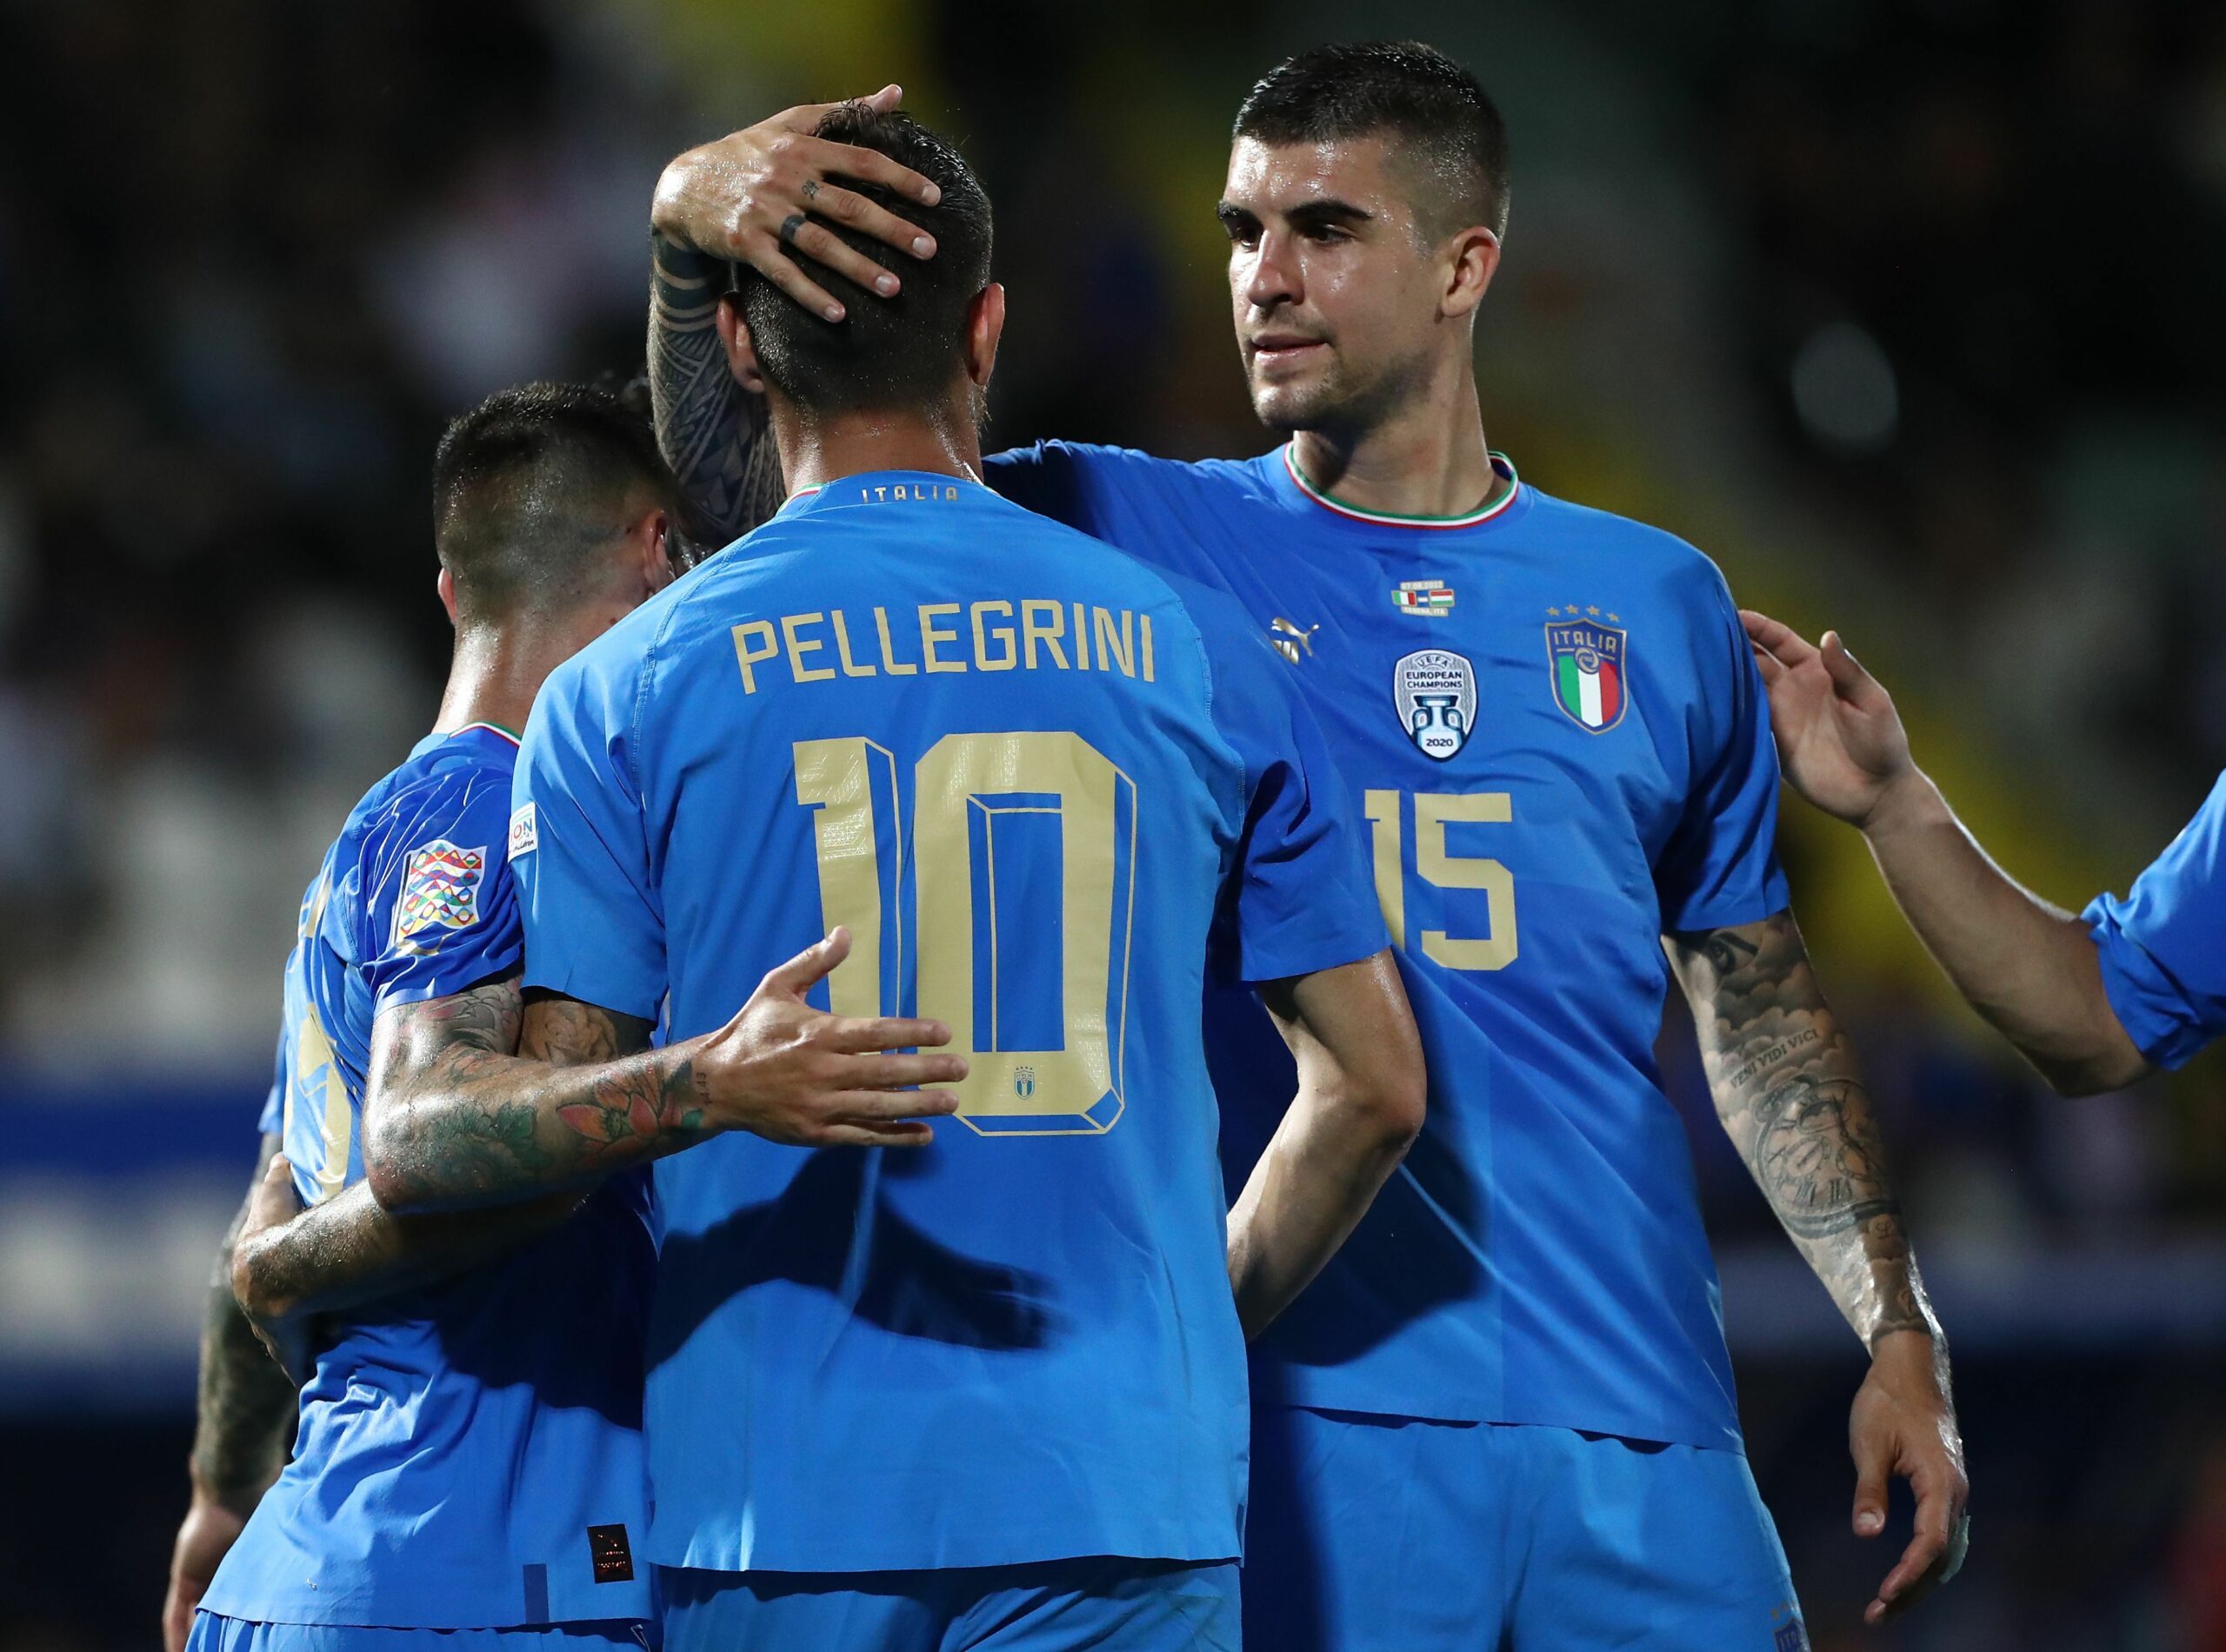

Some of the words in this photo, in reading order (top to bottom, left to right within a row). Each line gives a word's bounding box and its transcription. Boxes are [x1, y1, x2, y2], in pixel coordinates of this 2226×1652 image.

[862, 484, 957, 503] ITALIA
[731, 599, 1155, 695] PELLEGRINI
[1553, 630, 1617, 654] ITALIA
[1416, 656, 1449, 668] UEFA
[1406, 671, 1463, 680] EUROPEAN
[1426, 738, 1454, 747] 2020
[1364, 789, 1518, 971] 15
[792, 730, 1137, 1137] 10
[1730, 1061, 1757, 1089] VENI
[1757, 1044, 1789, 1067] VIDI
[1788, 1029, 1820, 1049] VICI
